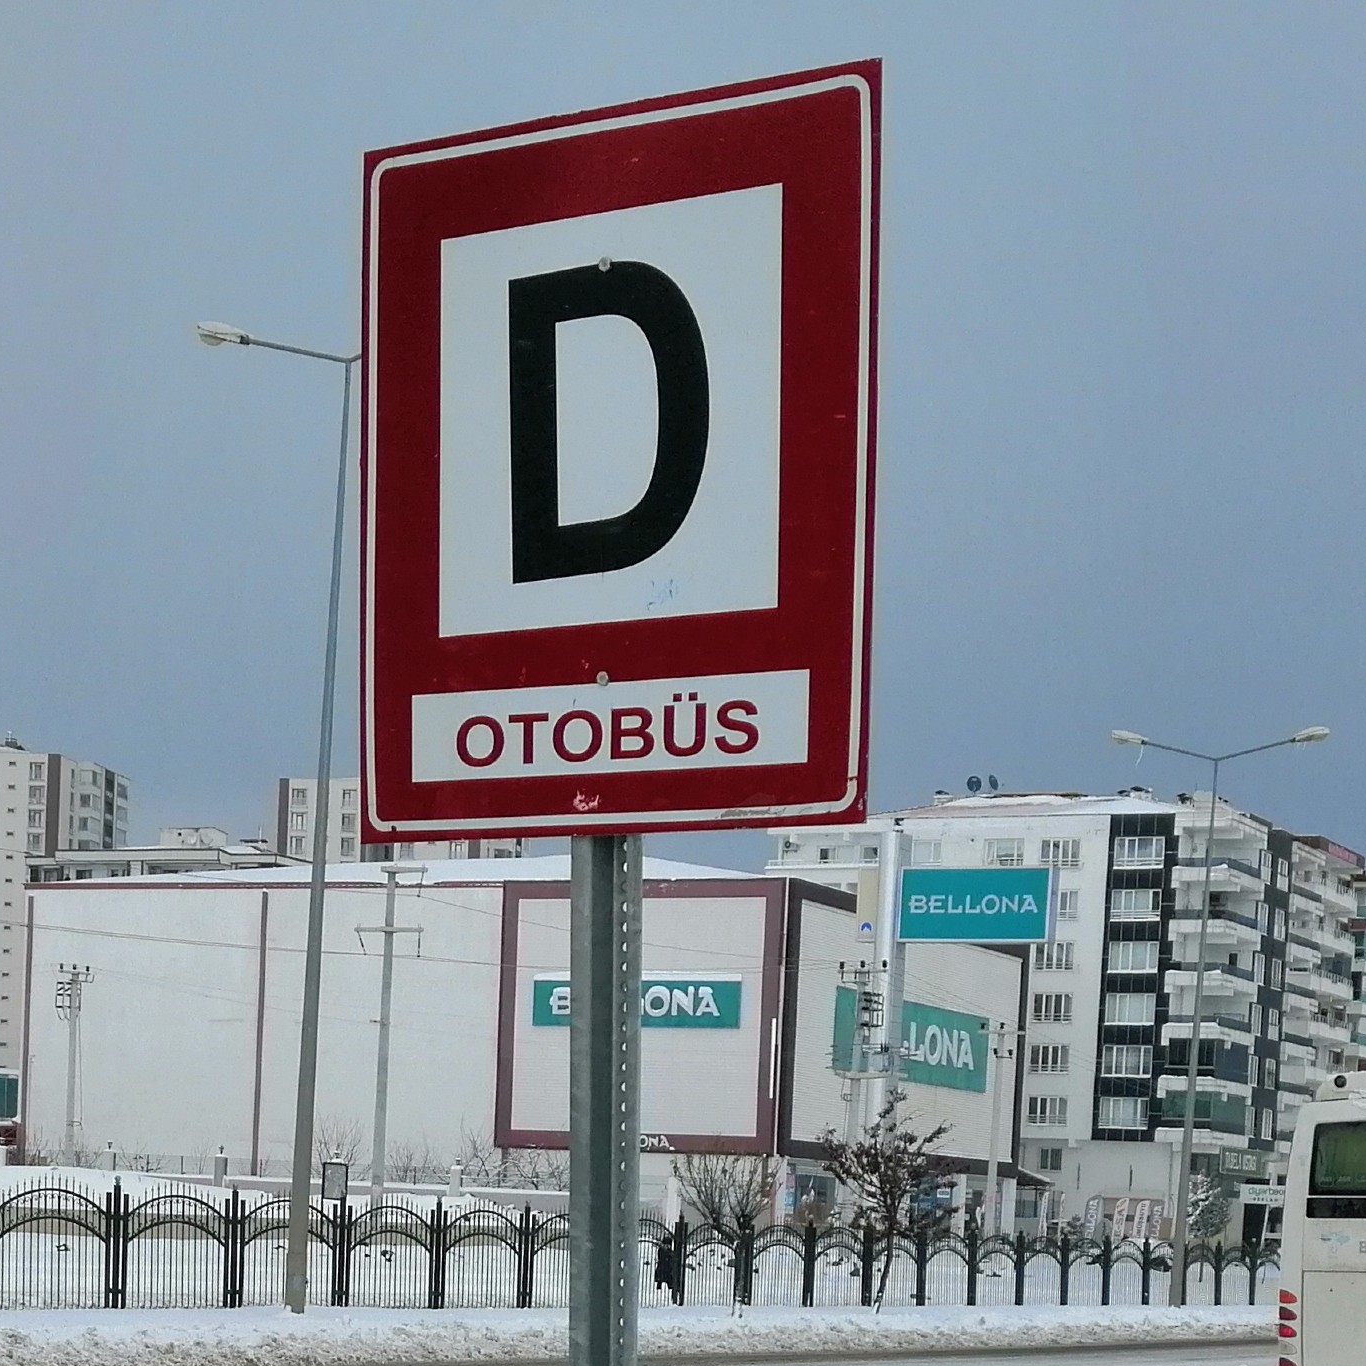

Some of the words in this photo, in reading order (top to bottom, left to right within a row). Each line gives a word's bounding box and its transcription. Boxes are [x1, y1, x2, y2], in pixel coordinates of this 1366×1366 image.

[508, 260, 710, 584] D
[456, 692, 760, 768] OTOBÜS
[908, 894, 1038, 914] BELLONA
